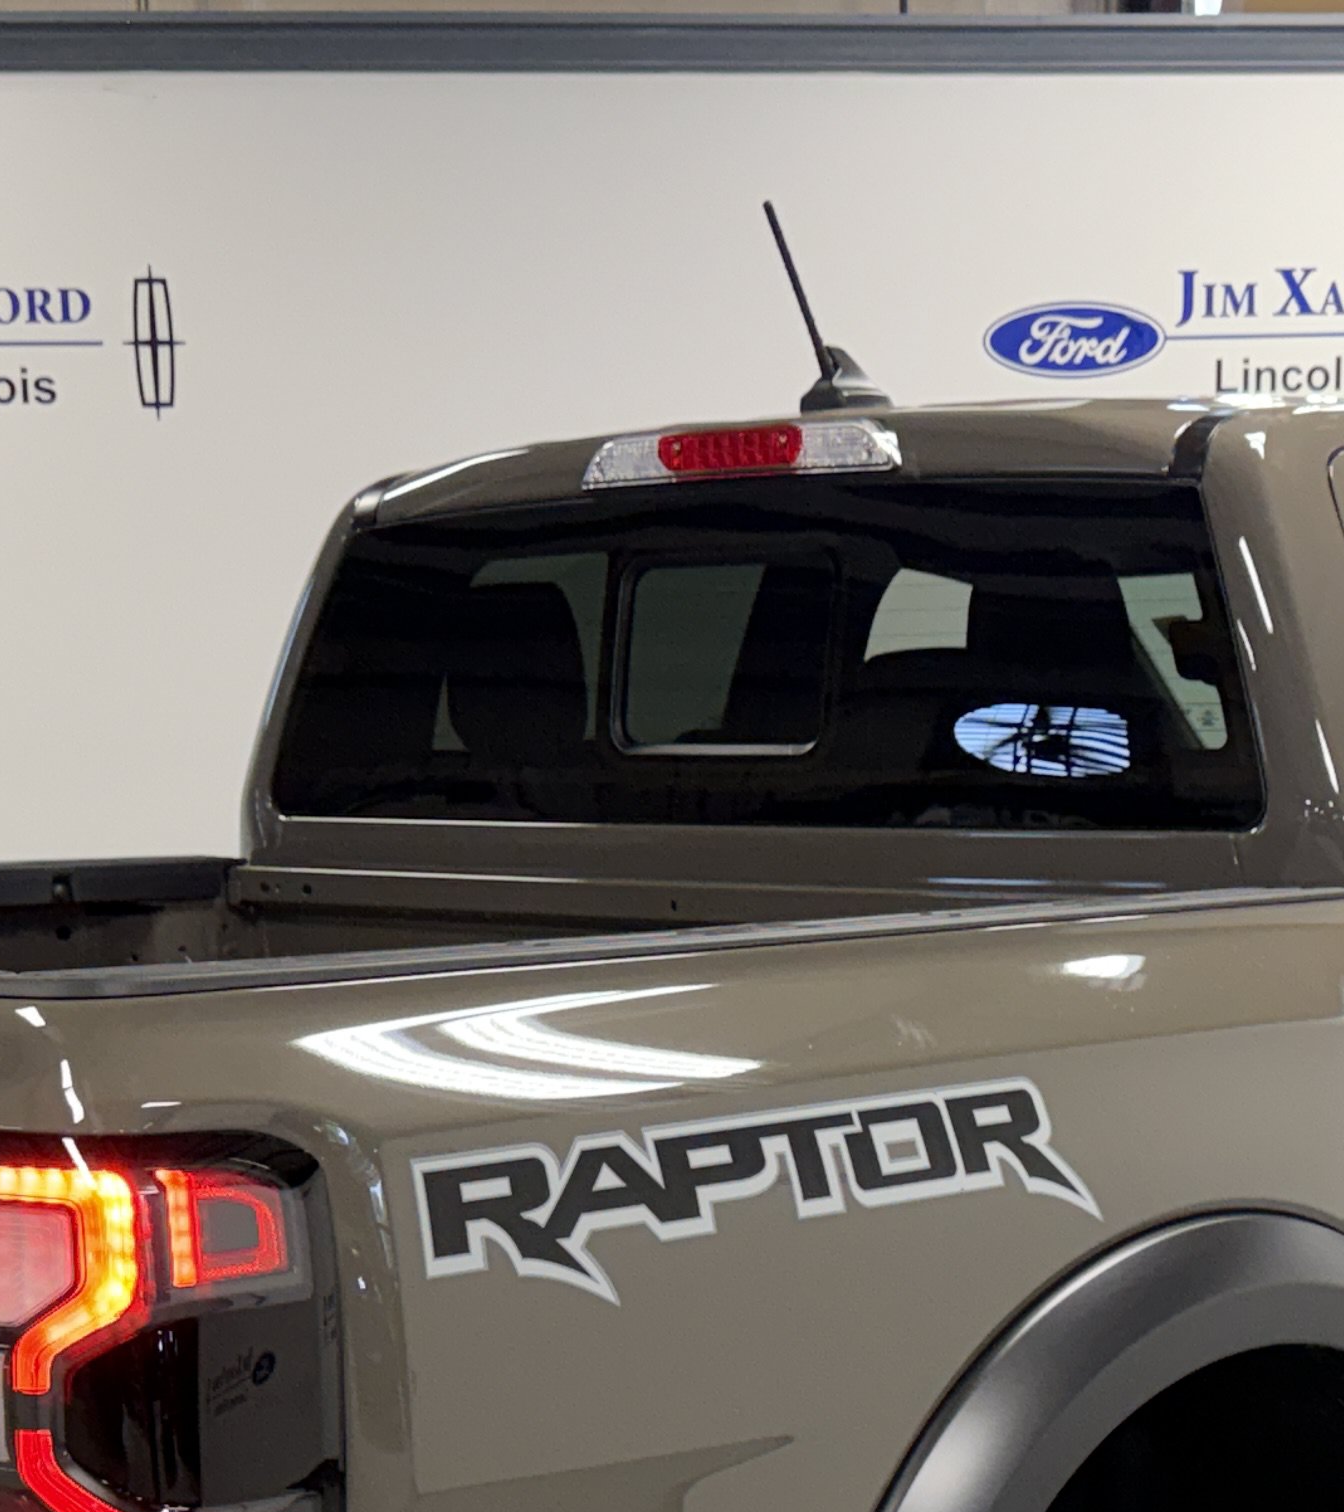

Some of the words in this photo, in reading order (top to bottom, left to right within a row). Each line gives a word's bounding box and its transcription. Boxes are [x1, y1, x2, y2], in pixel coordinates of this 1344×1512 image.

[1175, 269, 1258, 328] JIM
[1018, 314, 1132, 366] Ford
[411, 1076, 1103, 1306] RAPTOR
